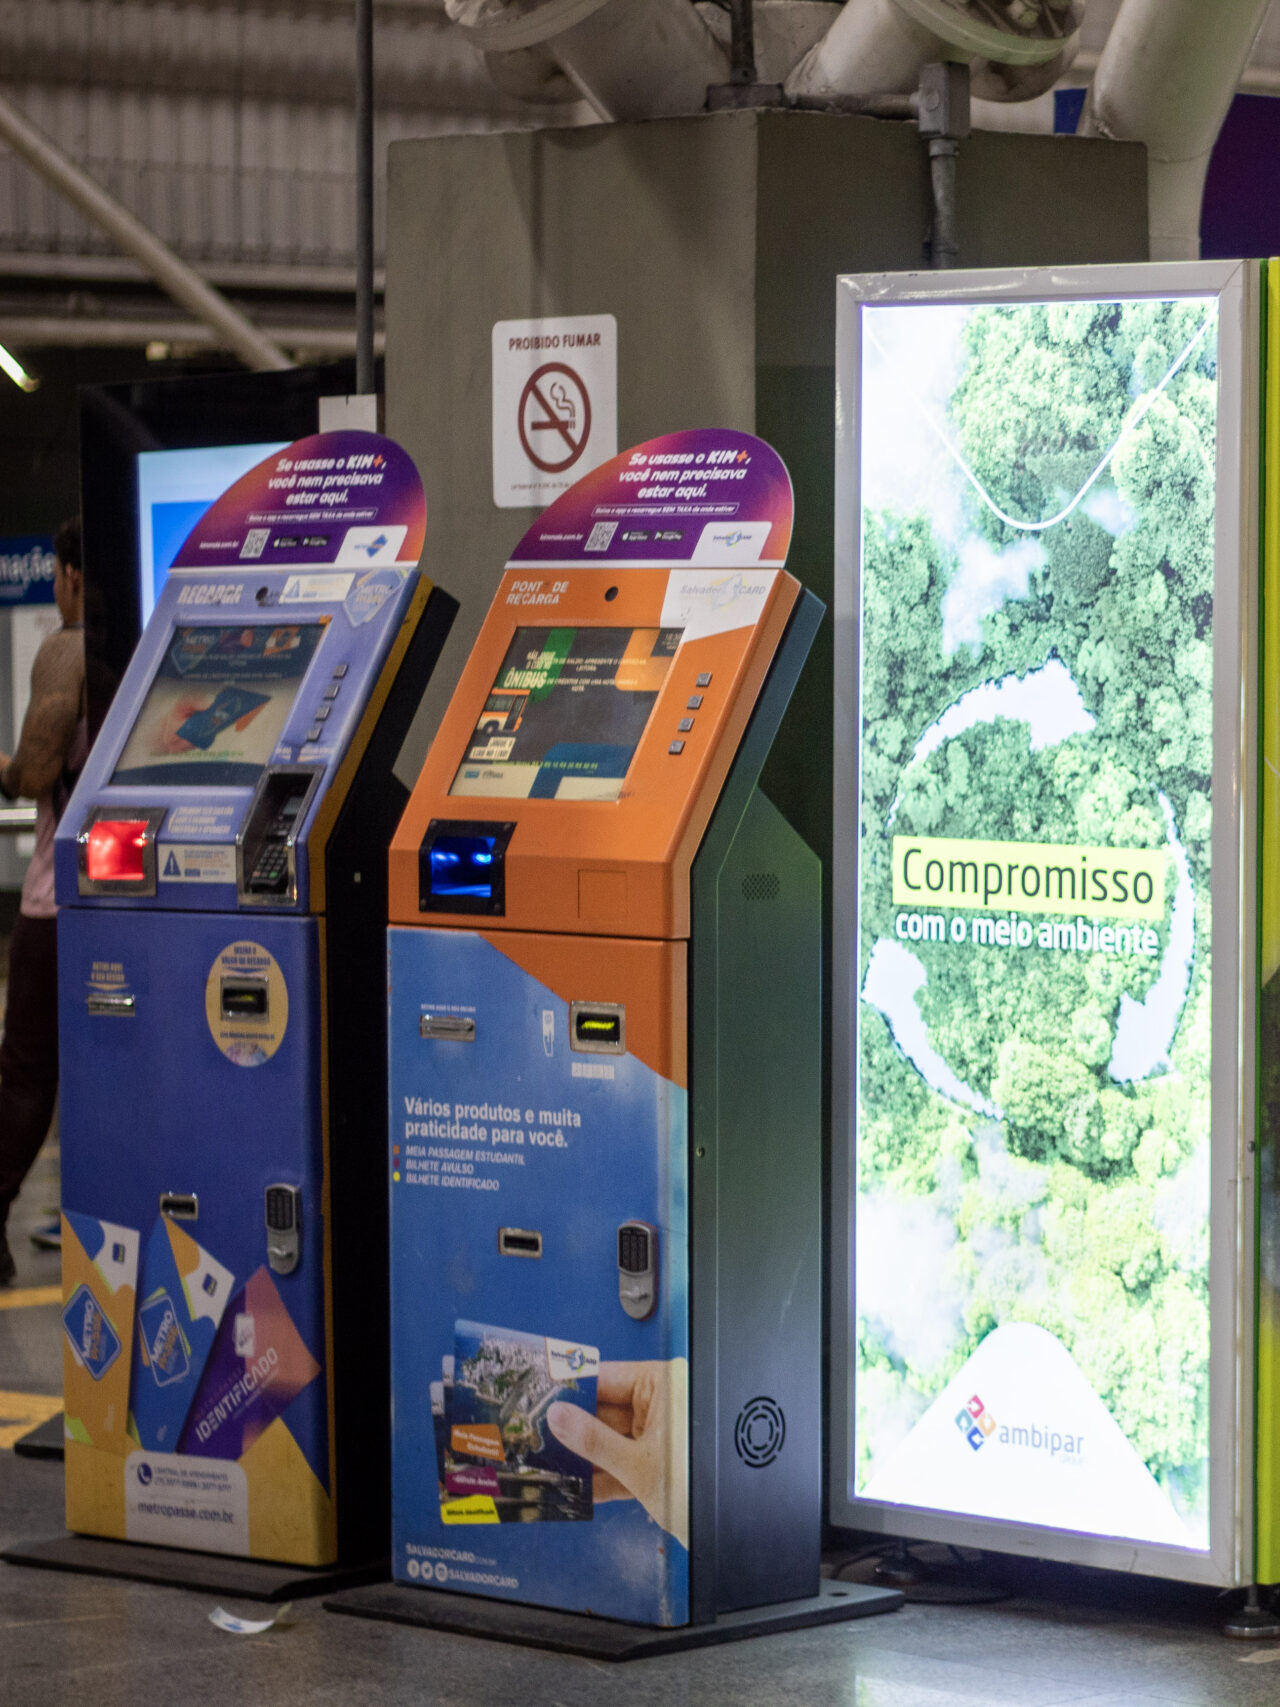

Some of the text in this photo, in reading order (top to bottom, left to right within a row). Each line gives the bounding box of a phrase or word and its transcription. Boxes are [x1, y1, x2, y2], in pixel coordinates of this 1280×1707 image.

[508, 332, 601, 351] PROIBIDO FUMAR
[276, 459, 293, 472] Se
[294, 458, 333, 471] usasse
[628, 453, 645, 466] Se
[648, 453, 694, 465] usasse
[695, 453, 705, 464] o
[268, 472, 383, 489] você nem precisava
[619, 466, 747, 484] você nem precisava
[285, 489, 319, 505] estar
[637, 484, 707, 501] estar aqui.
[551, 580, 569, 593] DE
[503, 667, 548, 689] ÔNIBUS
[903, 848, 1153, 905] Compromisso
[895, 911, 1159, 956] com o meio ambiente
[404, 1095, 582, 1128] Vários produtos e muita
[404, 1119, 569, 1149] praticidade para você.
[405, 1145, 526, 1166] MEIA PASSAGEM ESTUDANTIL
[441, 1175, 500, 1191] IDENTIFICADO
[195, 1347, 279, 1444] IDENTIFICADO
[999, 1423, 1085, 1455] ambipar
